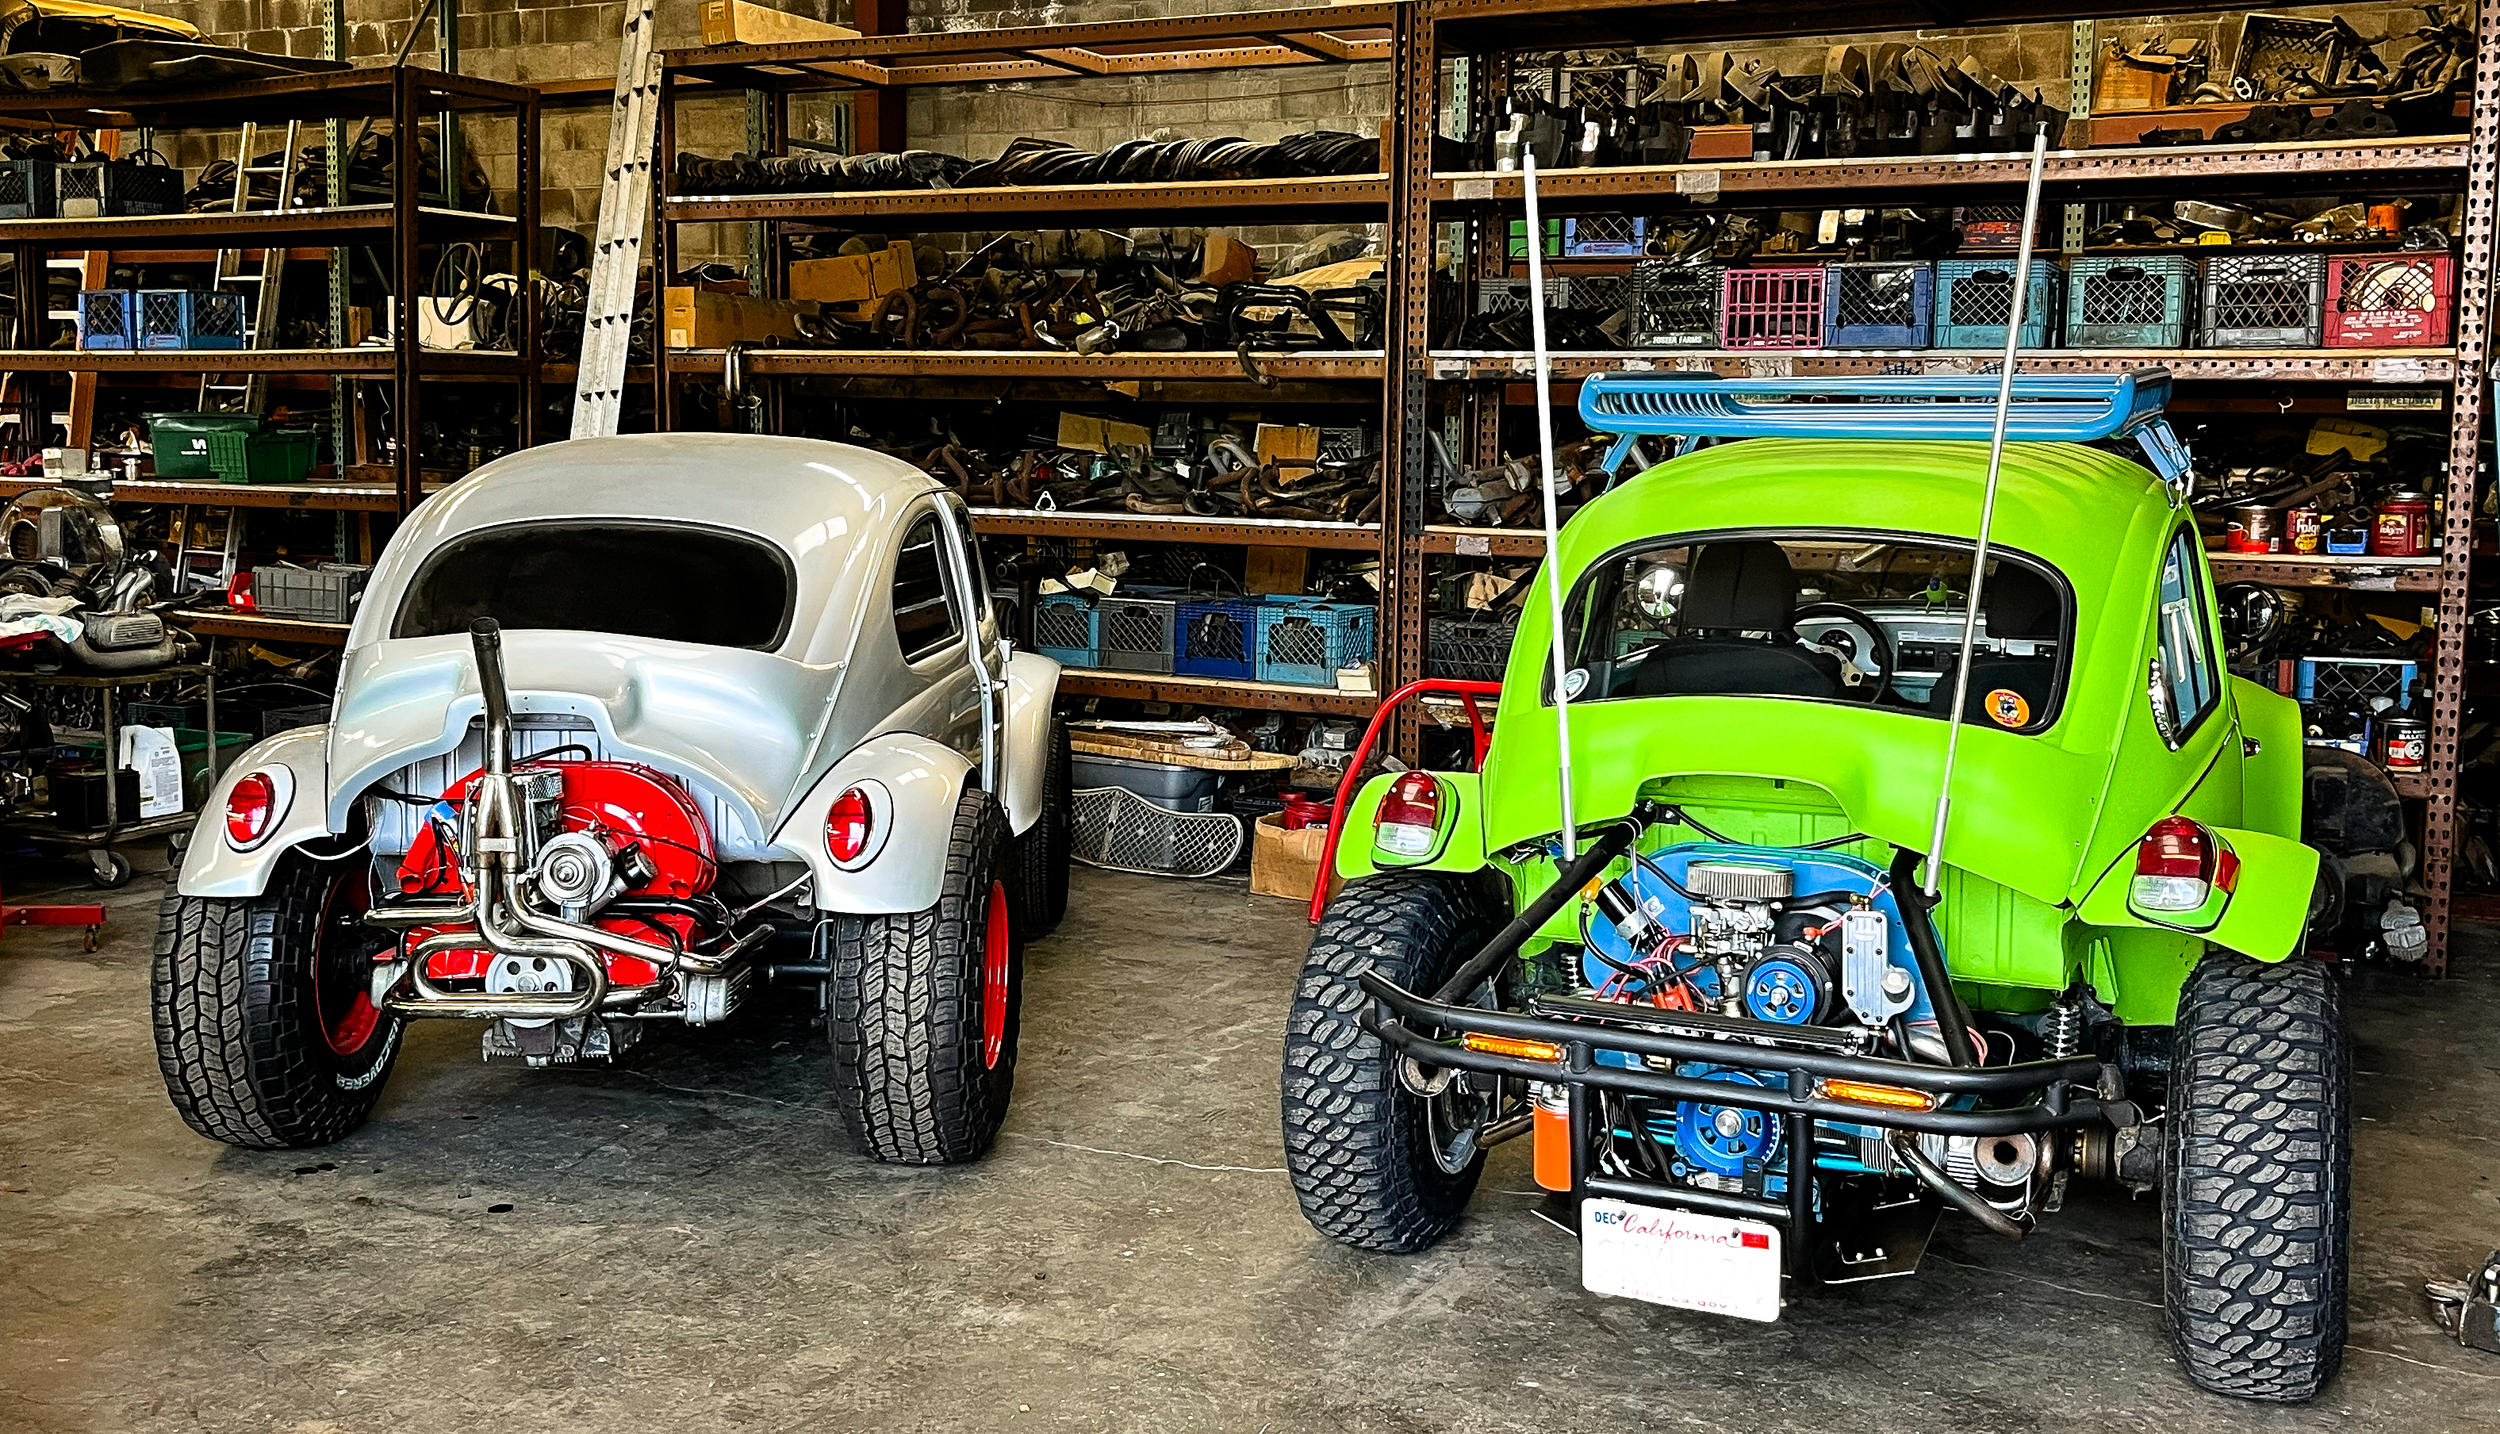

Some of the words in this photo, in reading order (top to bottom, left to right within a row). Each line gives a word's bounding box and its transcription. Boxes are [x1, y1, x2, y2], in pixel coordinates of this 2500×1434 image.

[1652, 336, 1677, 344] FOSTER
[1678, 336, 1702, 344] FARMS
[1594, 1211, 1617, 1225] DEC
[1623, 1213, 1731, 1246] California
